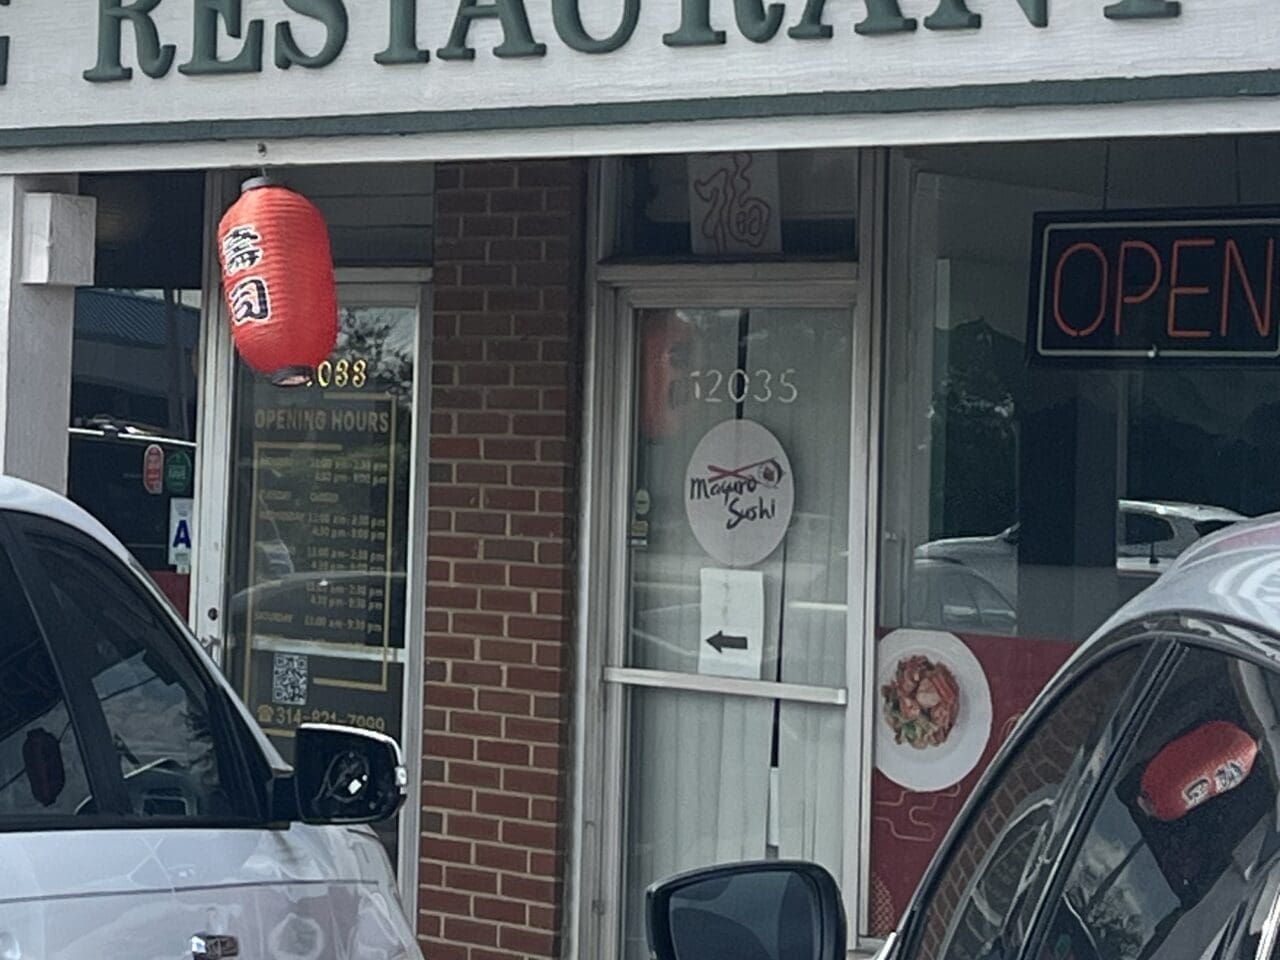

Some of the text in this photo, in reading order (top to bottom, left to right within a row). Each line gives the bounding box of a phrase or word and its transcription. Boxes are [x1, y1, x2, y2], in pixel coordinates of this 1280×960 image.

[1053, 238, 1274, 337] OPEN
[690, 369, 798, 403] 12035
[254, 407, 389, 433] OPENING HOURS
[173, 519, 192, 548] A
